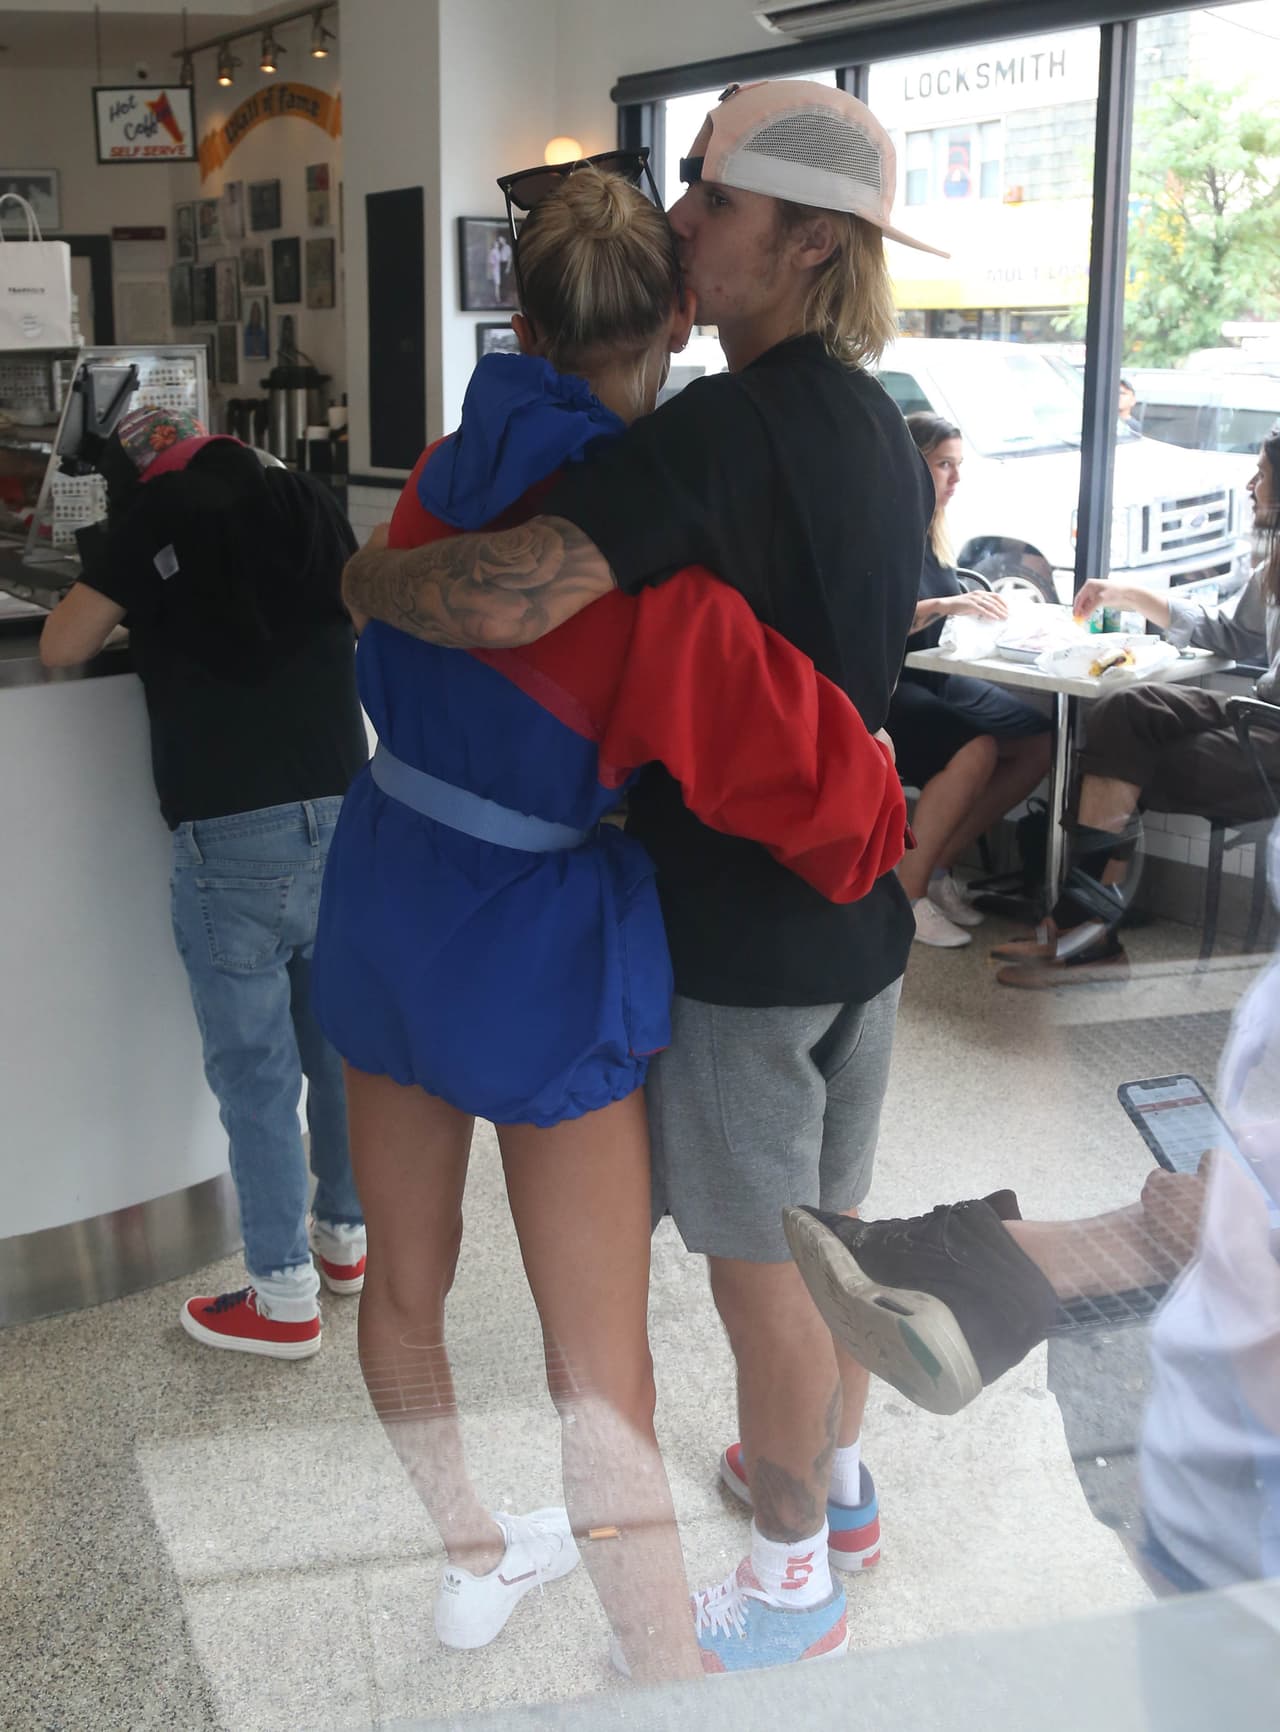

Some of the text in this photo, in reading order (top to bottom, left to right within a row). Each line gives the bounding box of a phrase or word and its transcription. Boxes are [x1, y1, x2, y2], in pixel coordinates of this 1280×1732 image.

[904, 49, 1065, 101] LOCKSMITH
[109, 94, 136, 122] Hot
[110, 145, 186, 157] SELF SERVE
